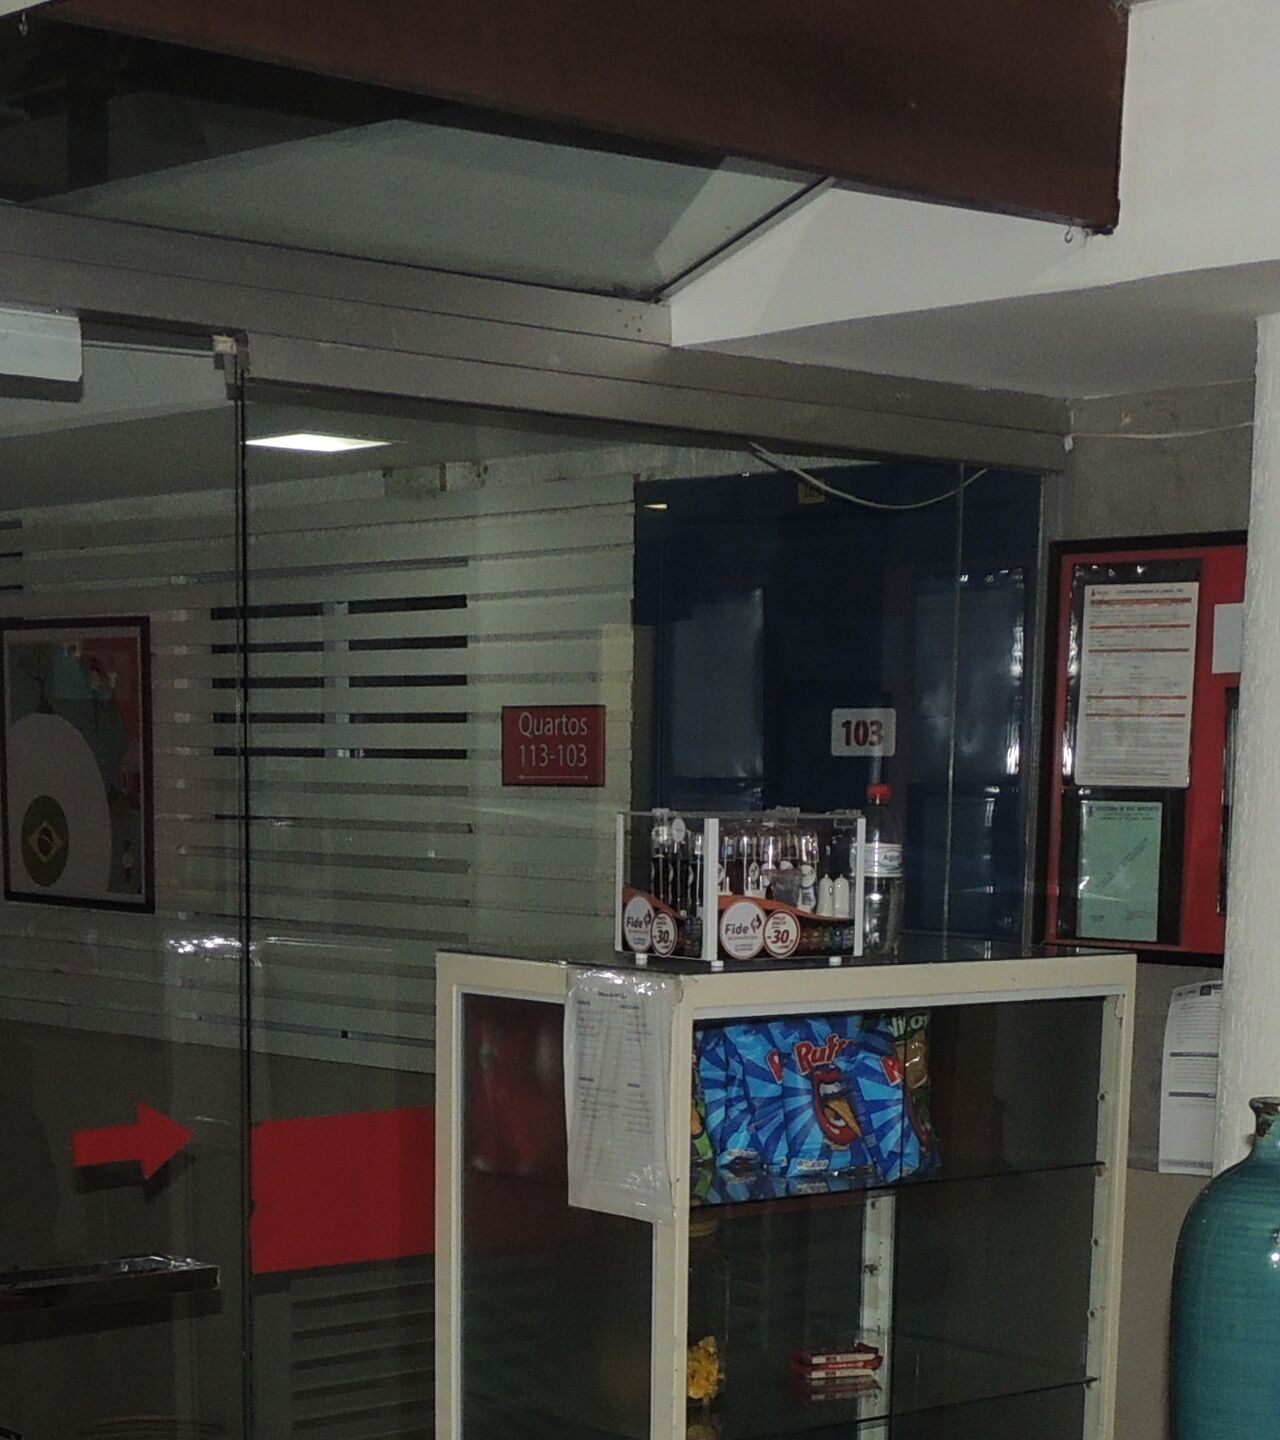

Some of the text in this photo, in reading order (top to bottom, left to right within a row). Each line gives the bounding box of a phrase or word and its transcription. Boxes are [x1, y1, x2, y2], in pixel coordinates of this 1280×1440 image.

[519, 711, 588, 738] Quartos
[842, 719, 884, 747] 103
[519, 743, 587, 767] 113-103
[725, 923, 749, 935] Fide
[771, 929, 790, 944] 30
[794, 1032, 854, 1076] Ruff
